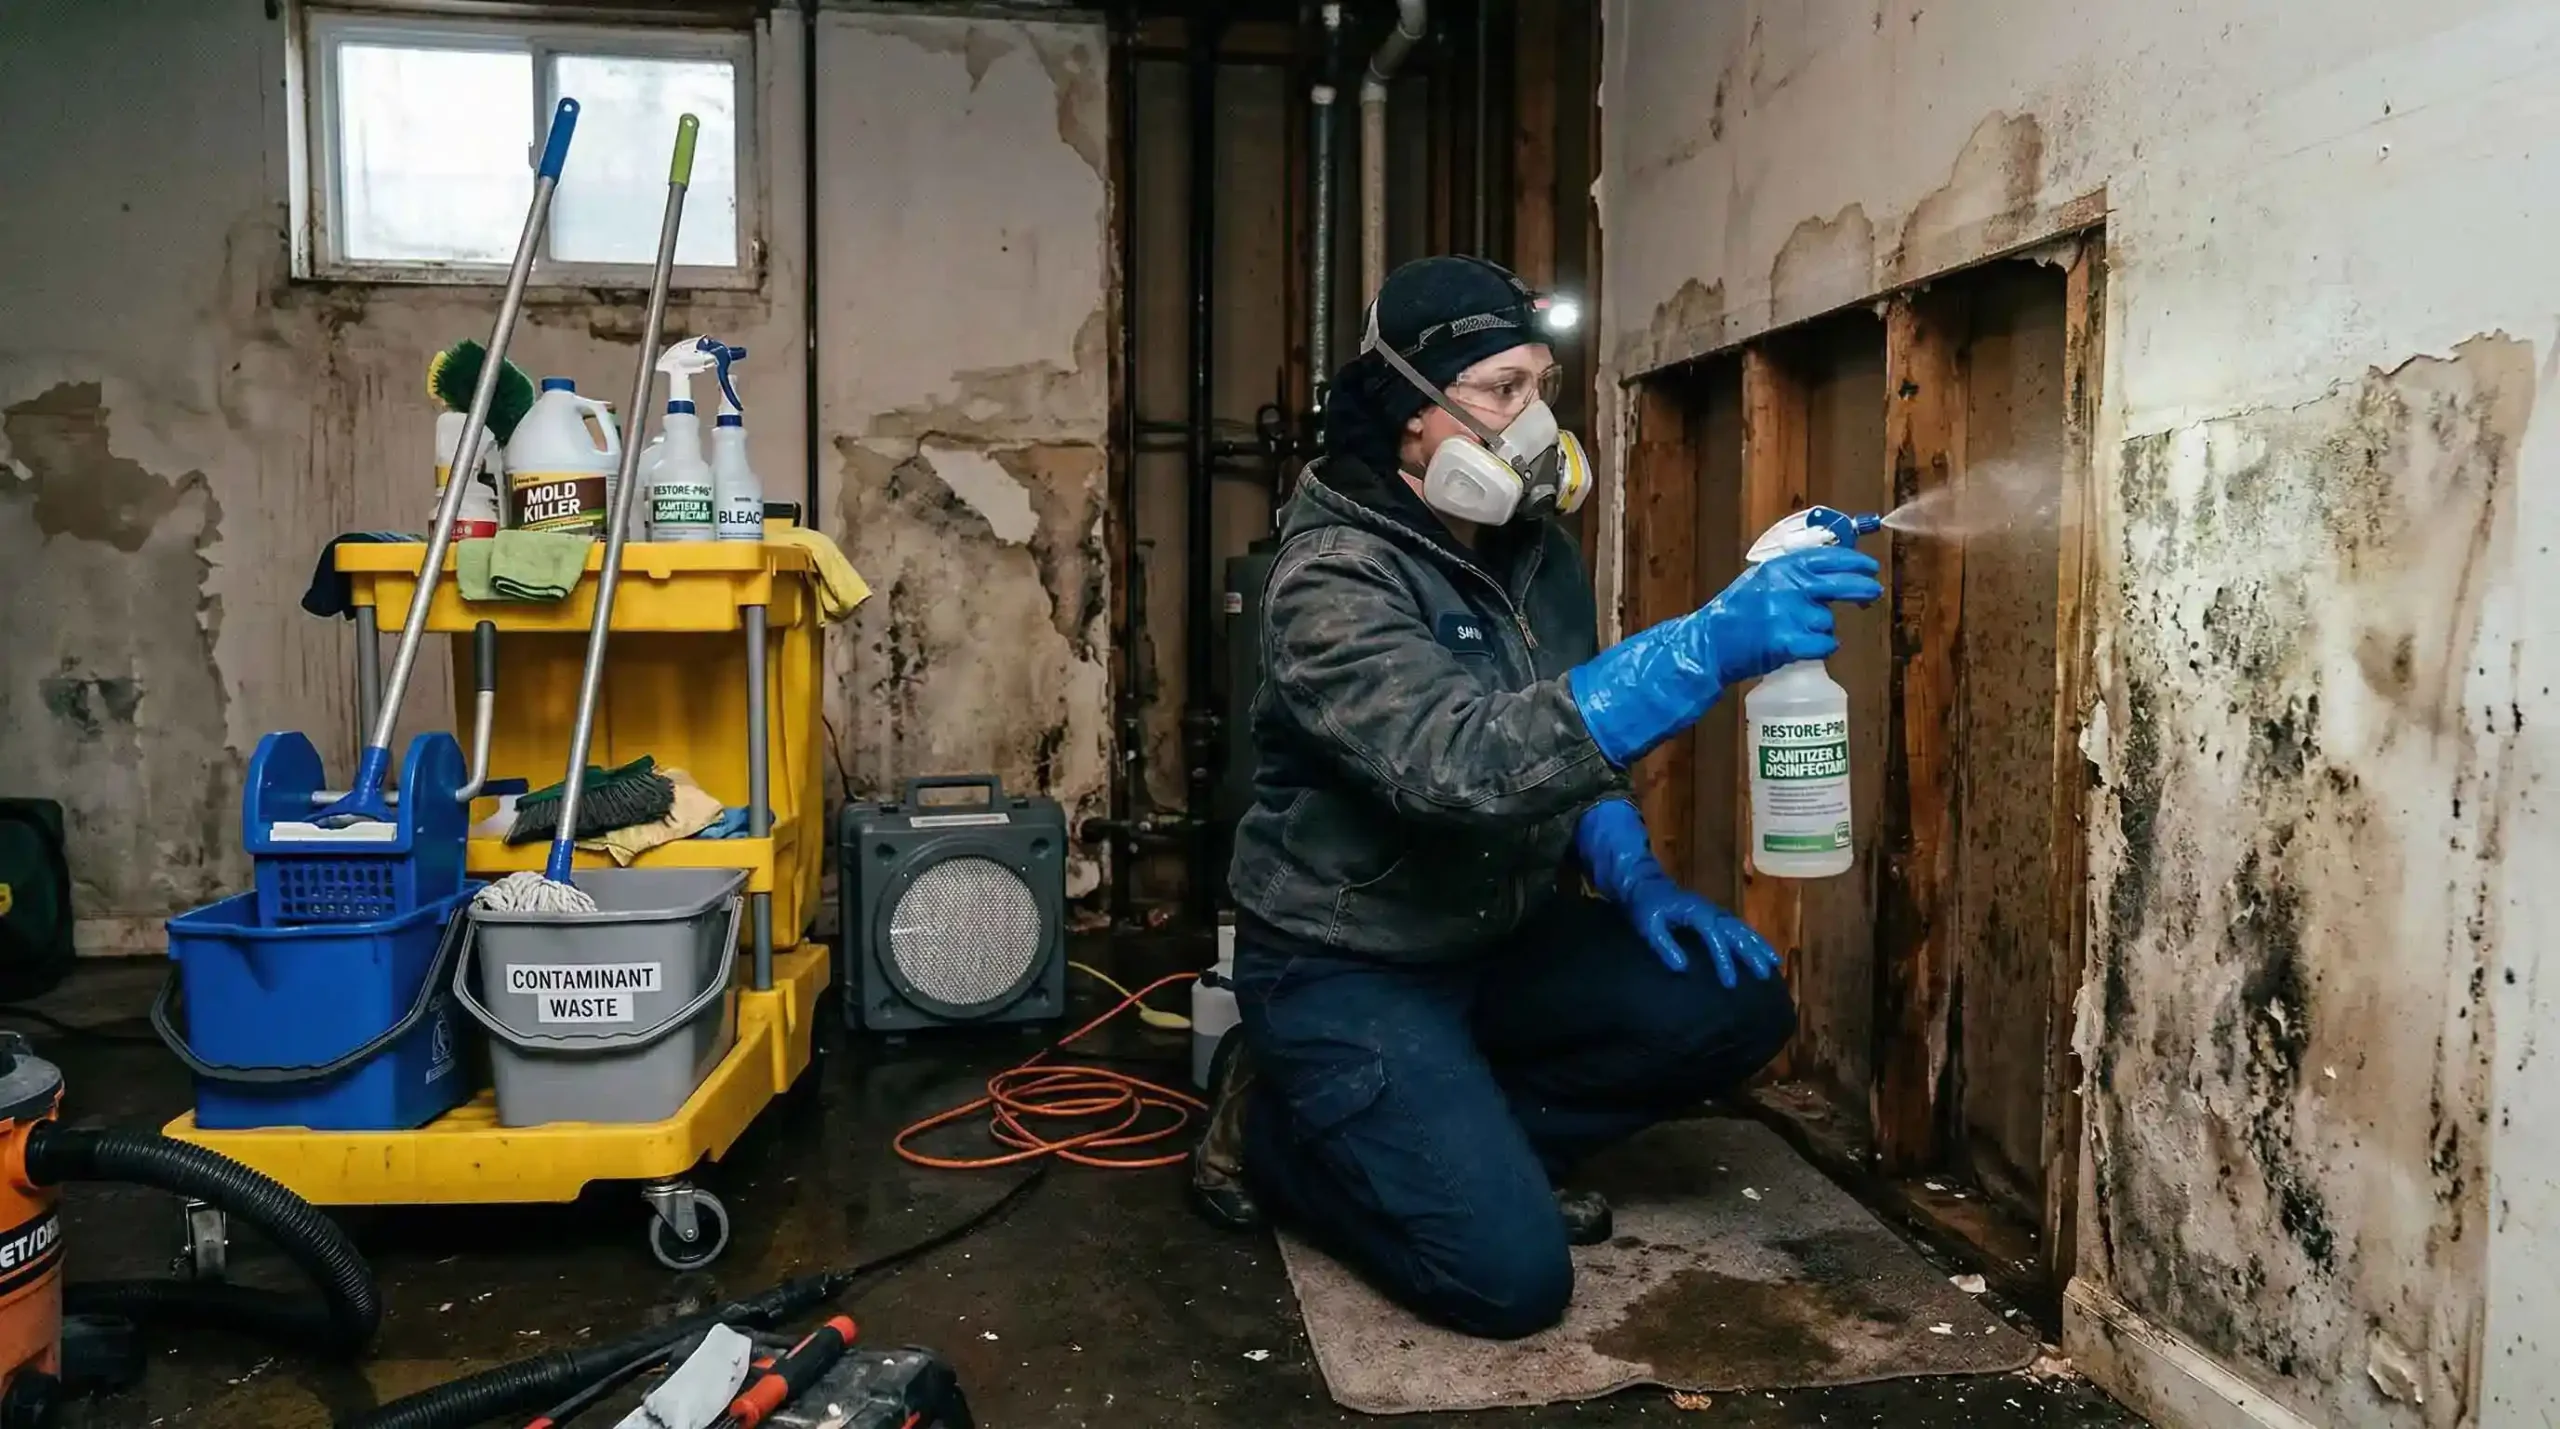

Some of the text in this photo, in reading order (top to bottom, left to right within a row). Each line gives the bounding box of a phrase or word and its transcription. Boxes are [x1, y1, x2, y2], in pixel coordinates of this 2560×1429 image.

[526, 482, 577, 506] MOLD
[523, 498, 581, 523] KILLER
[718, 509, 761, 525] BLEAC
[1767, 745, 1844, 764] SANITIZER &
[512, 967, 654, 990] CONTAMINANT
[549, 998, 618, 1018] WASTE
